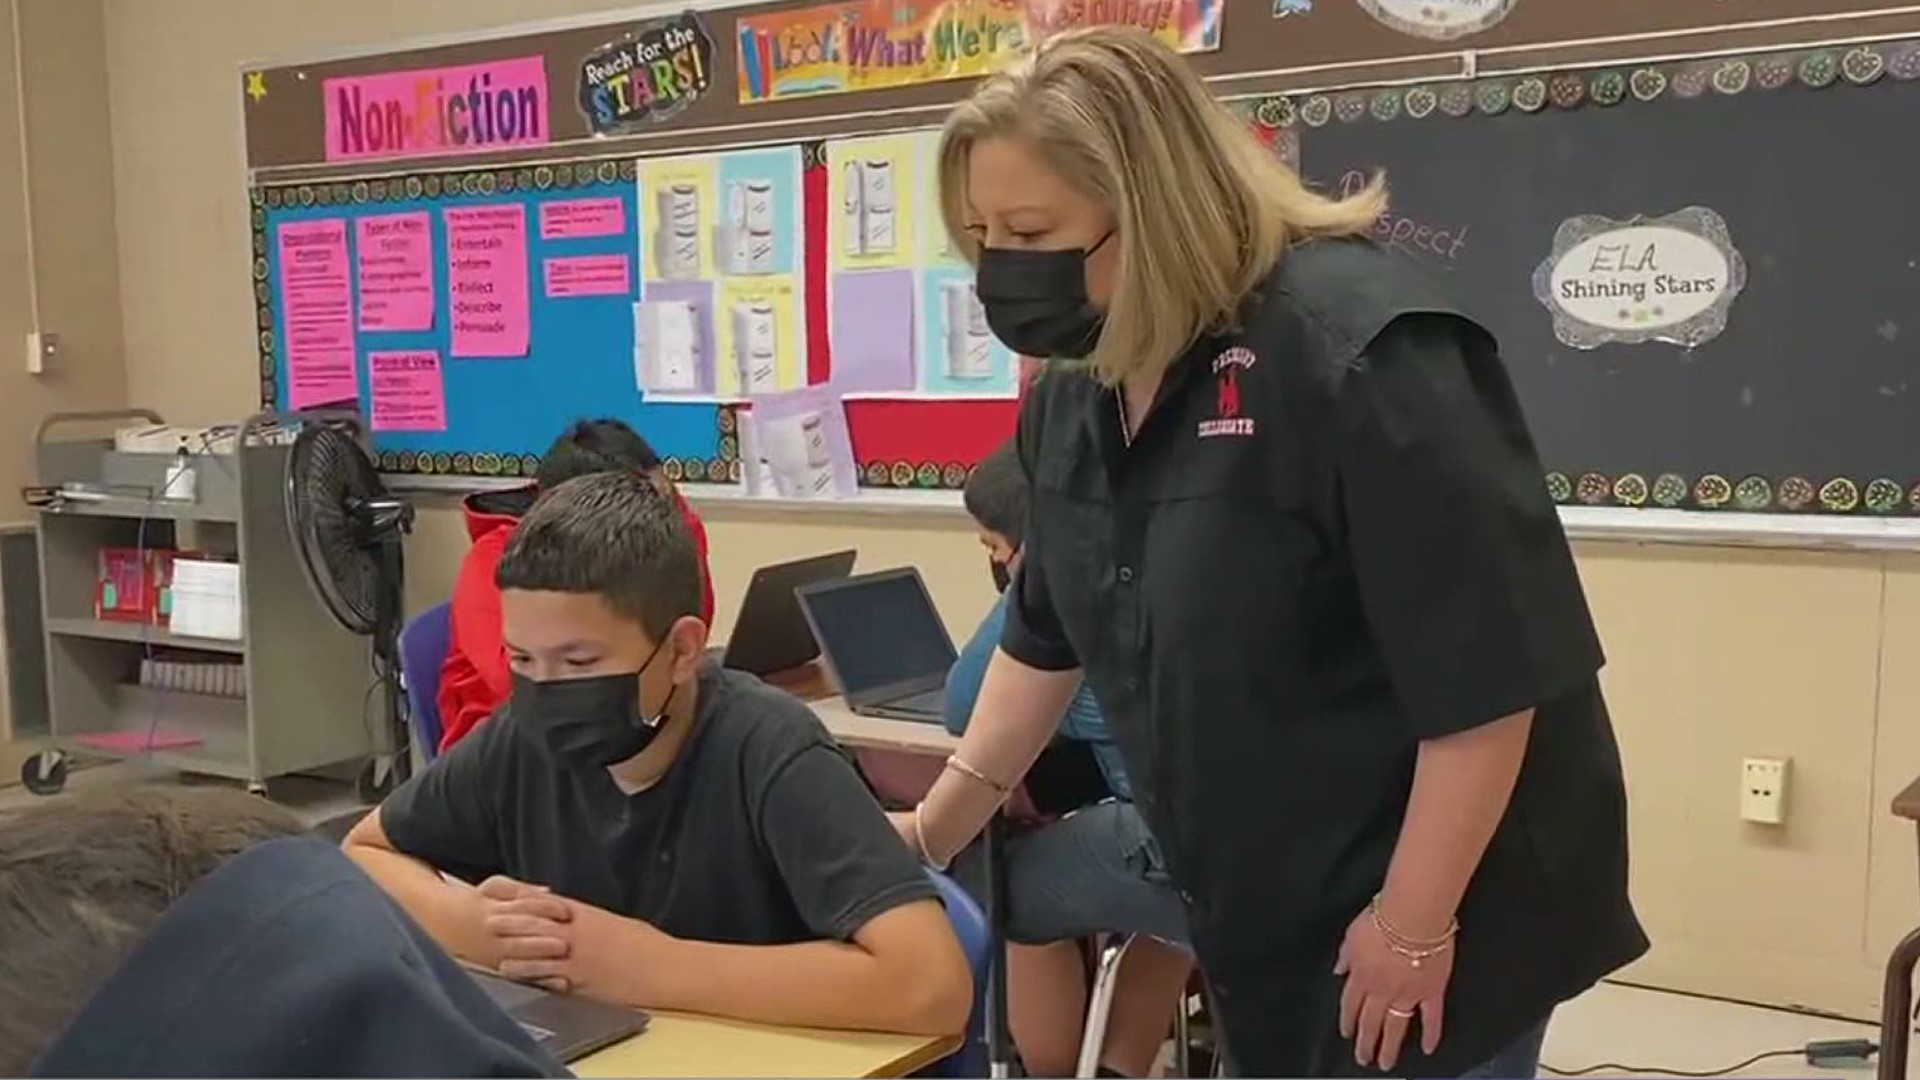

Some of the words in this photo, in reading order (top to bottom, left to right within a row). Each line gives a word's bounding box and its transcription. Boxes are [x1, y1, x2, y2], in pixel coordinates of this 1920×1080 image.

[586, 51, 633, 85] Reach
[636, 42, 663, 63] for
[664, 28, 695, 50] the
[849, 26, 925, 67] What
[934, 15, 1029, 62] We're
[592, 43, 706, 124] STARS!
[338, 73, 539, 153] Non-Fiction
[1588, 242, 1659, 273] ELA
[1561, 278, 1646, 303] Shining
[1654, 274, 1718, 295] Stars
